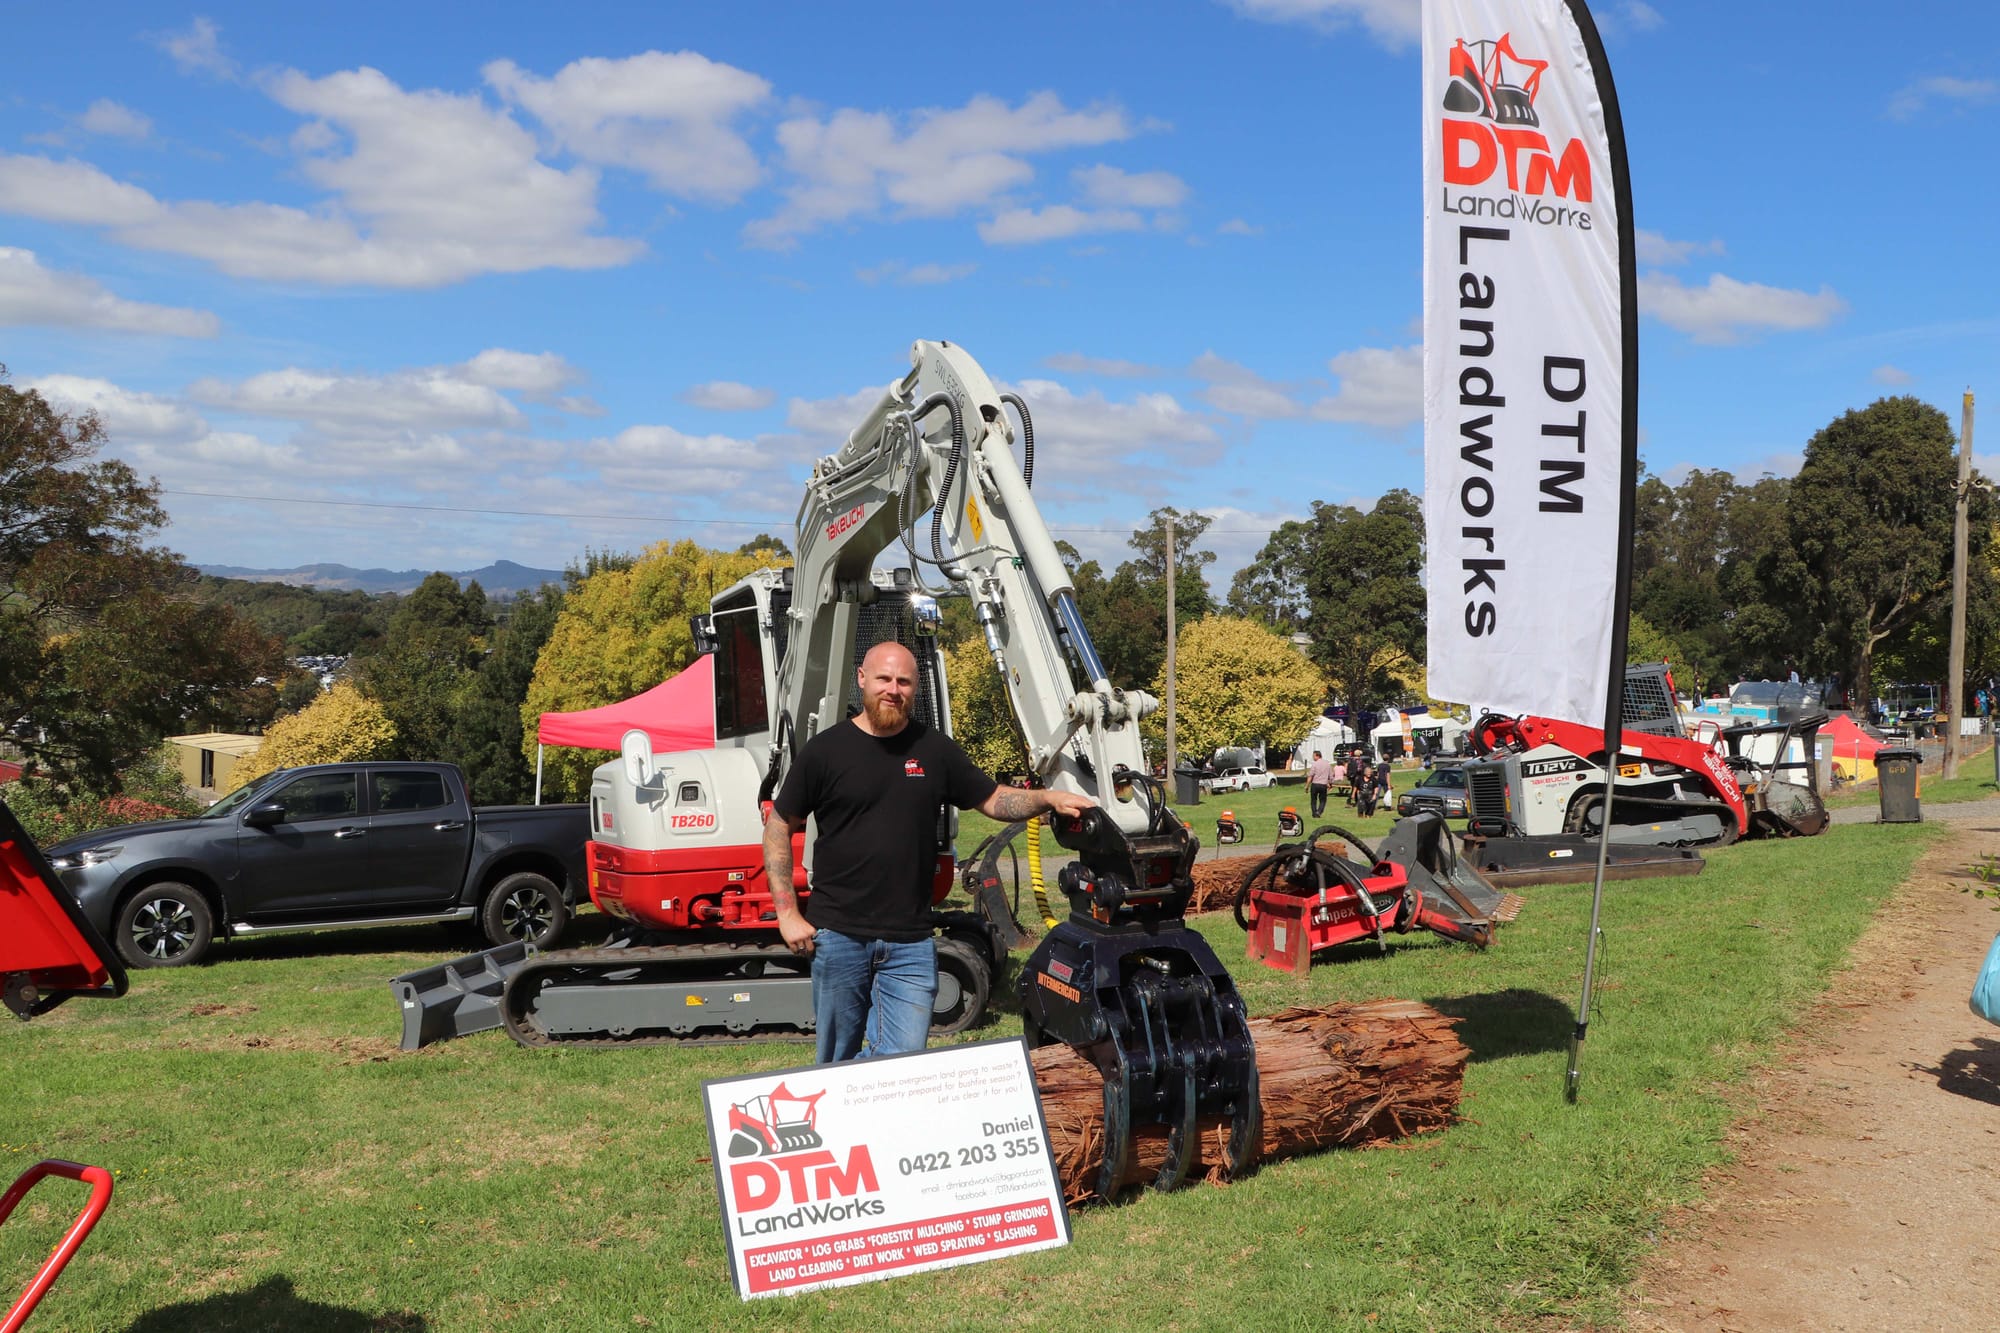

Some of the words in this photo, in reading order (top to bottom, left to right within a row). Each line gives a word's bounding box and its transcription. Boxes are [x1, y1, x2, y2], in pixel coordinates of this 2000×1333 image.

[1442, 118, 1592, 203] DTM
[1443, 187, 1592, 230] LandWorks
[1458, 225, 1510, 638] Landworks
[1539, 356, 1586, 514] DTM
[671, 814, 715, 828] TB260
[844, 1097, 850, 1106] Is
[852, 1095, 870, 1106] your
[872, 1090, 906, 1104] property
[908, 1084, 942, 1099] prepared
[944, 1082, 954, 1091] for
[958, 1074, 986, 1089] bushfire
[846, 1083, 858, 1093] Do
[861, 1084, 875, 1093] you
[877, 1078, 896, 1089] have
[898, 1073, 938, 1088] overgrown
[940, 1068, 956, 1079] land
[958, 1066, 979, 1080] going
[981, 1064, 989, 1073] to
[938, 1094, 949, 1104] Let
[952, 1093, 960, 1102] us
[962, 1089, 980, 1100] clear
[984, 1088, 988, 1098] it
[992, 1086, 1002, 1096] for
[982, 1114, 1034, 1137] Daniel
[899, 1151, 952, 1176] 0422
[957, 1143, 998, 1166] 203
[1002, 1136, 1040, 1158] 355
[730, 1144, 880, 1214] DTM
[738, 1198, 886, 1237] LandWorks
[750, 1247, 803, 1268] EXCAVATOR
[812, 1243, 832, 1258] LOG
[834, 1237, 866, 1254] GRABS
[917, 1220, 964, 1238] MULCHING
[973, 1212, 1002, 1229] STUMP
[1004, 1204, 1048, 1223] GRINDING
[768, 1268, 796, 1283] LAND
[798, 1259, 844, 1278] CLEARING
[852, 1253, 874, 1268] DIRT
[876, 1248, 905, 1264] WORK
[912, 1242, 938, 1258] WEED
[940, 1234, 986, 1252] SPRAYING
[994, 1224, 1038, 1243] SLASHING
